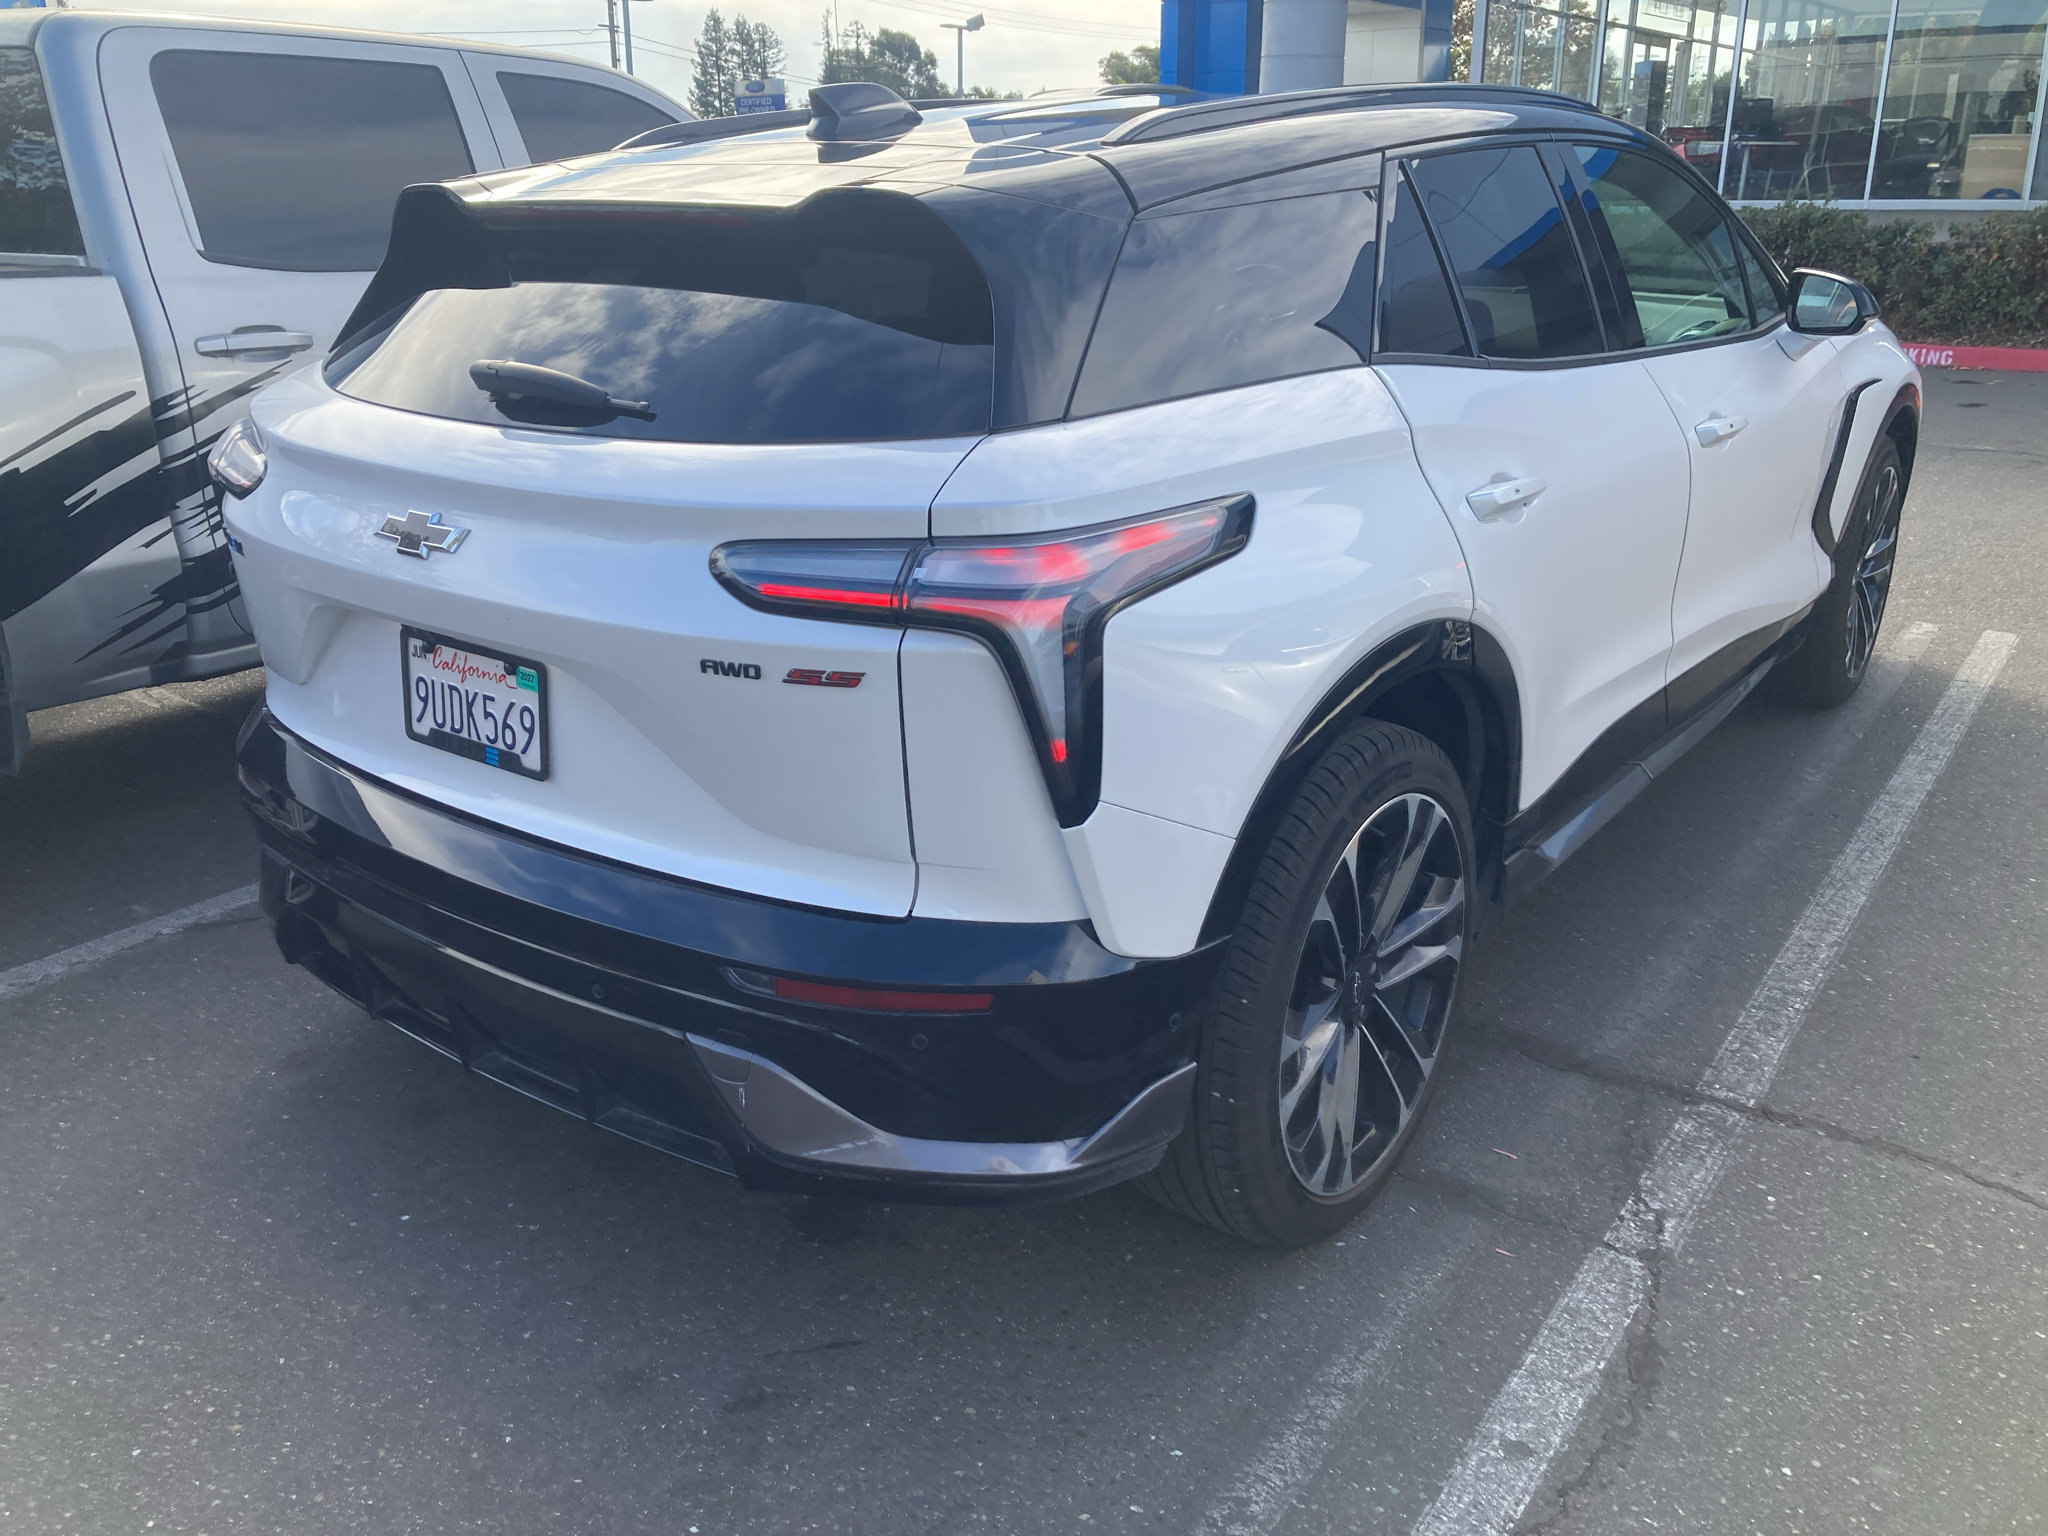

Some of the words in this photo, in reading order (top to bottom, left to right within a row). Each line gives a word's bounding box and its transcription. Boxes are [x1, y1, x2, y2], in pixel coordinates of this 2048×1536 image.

[740, 97, 772, 106] CERTIFIED
[432, 646, 518, 690] California
[700, 658, 762, 680] AWD
[782, 668, 866, 688] SS
[415, 676, 535, 755] 9UDK569
